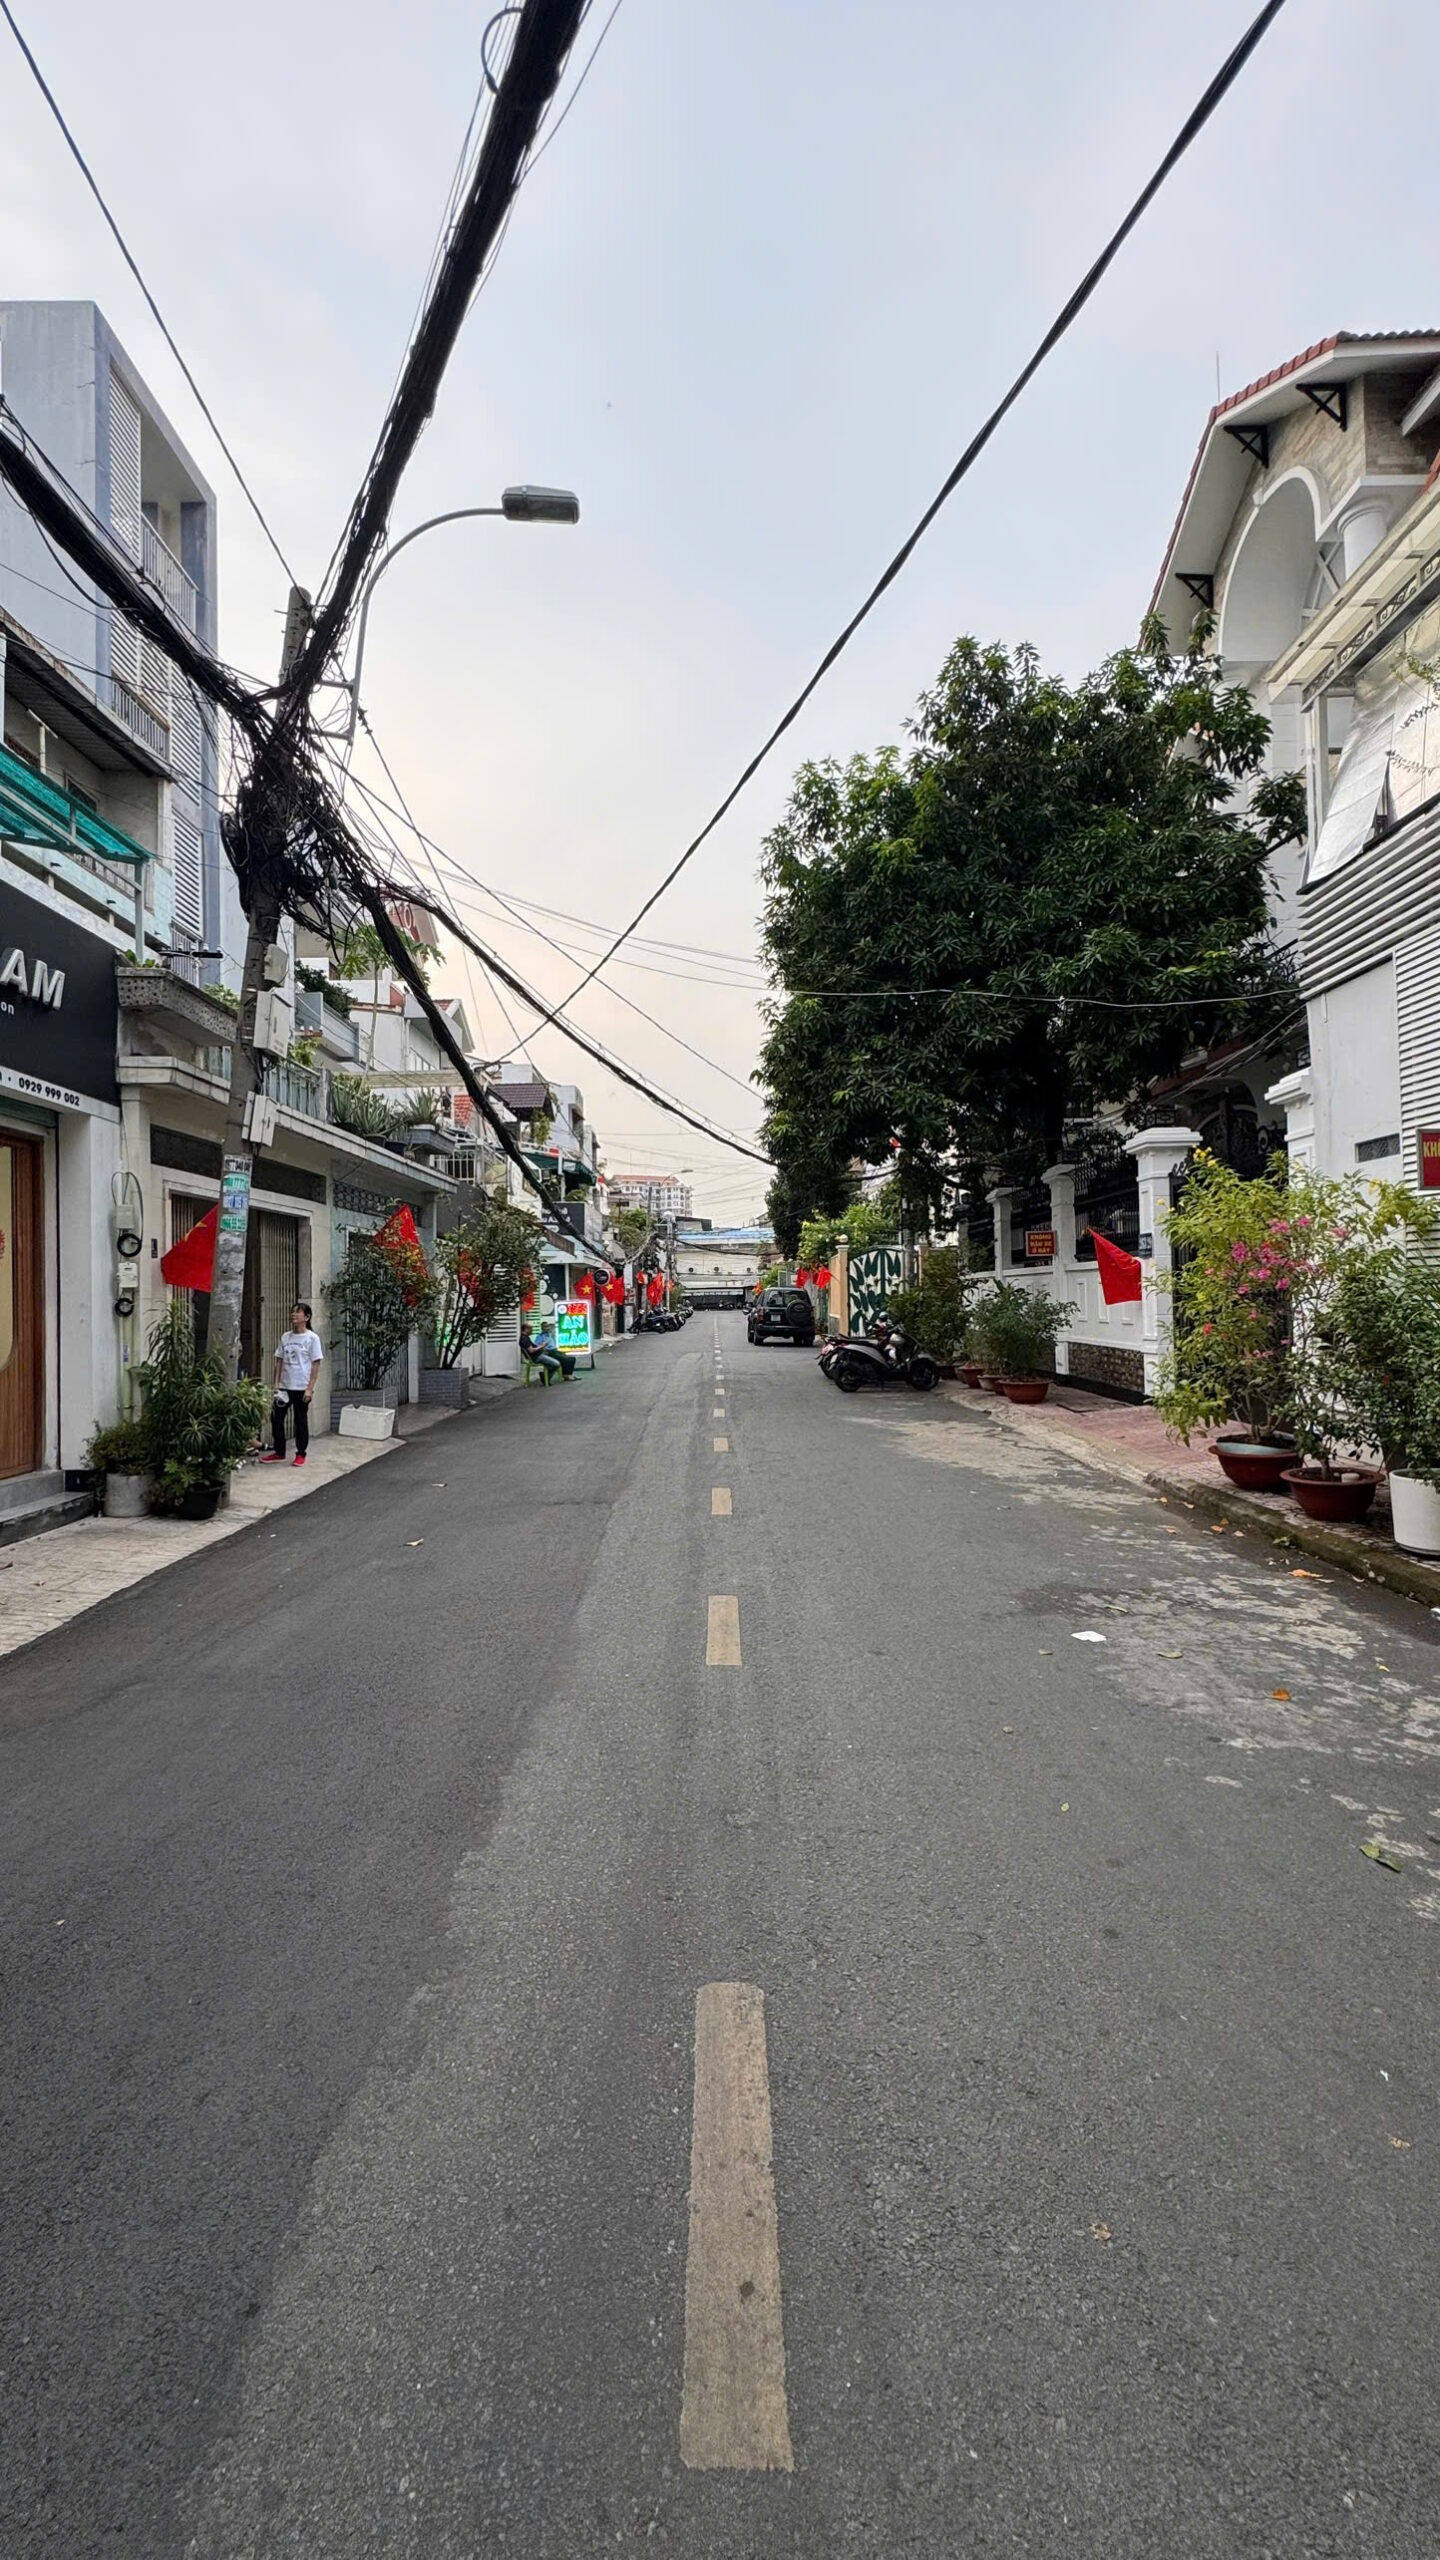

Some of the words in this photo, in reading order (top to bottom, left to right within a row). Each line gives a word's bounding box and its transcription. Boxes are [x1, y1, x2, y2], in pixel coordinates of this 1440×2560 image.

[19, 1077, 42, 1093] 0929
[45, 1086, 61, 1100] 999
[64, 1093, 80, 1106] 002
